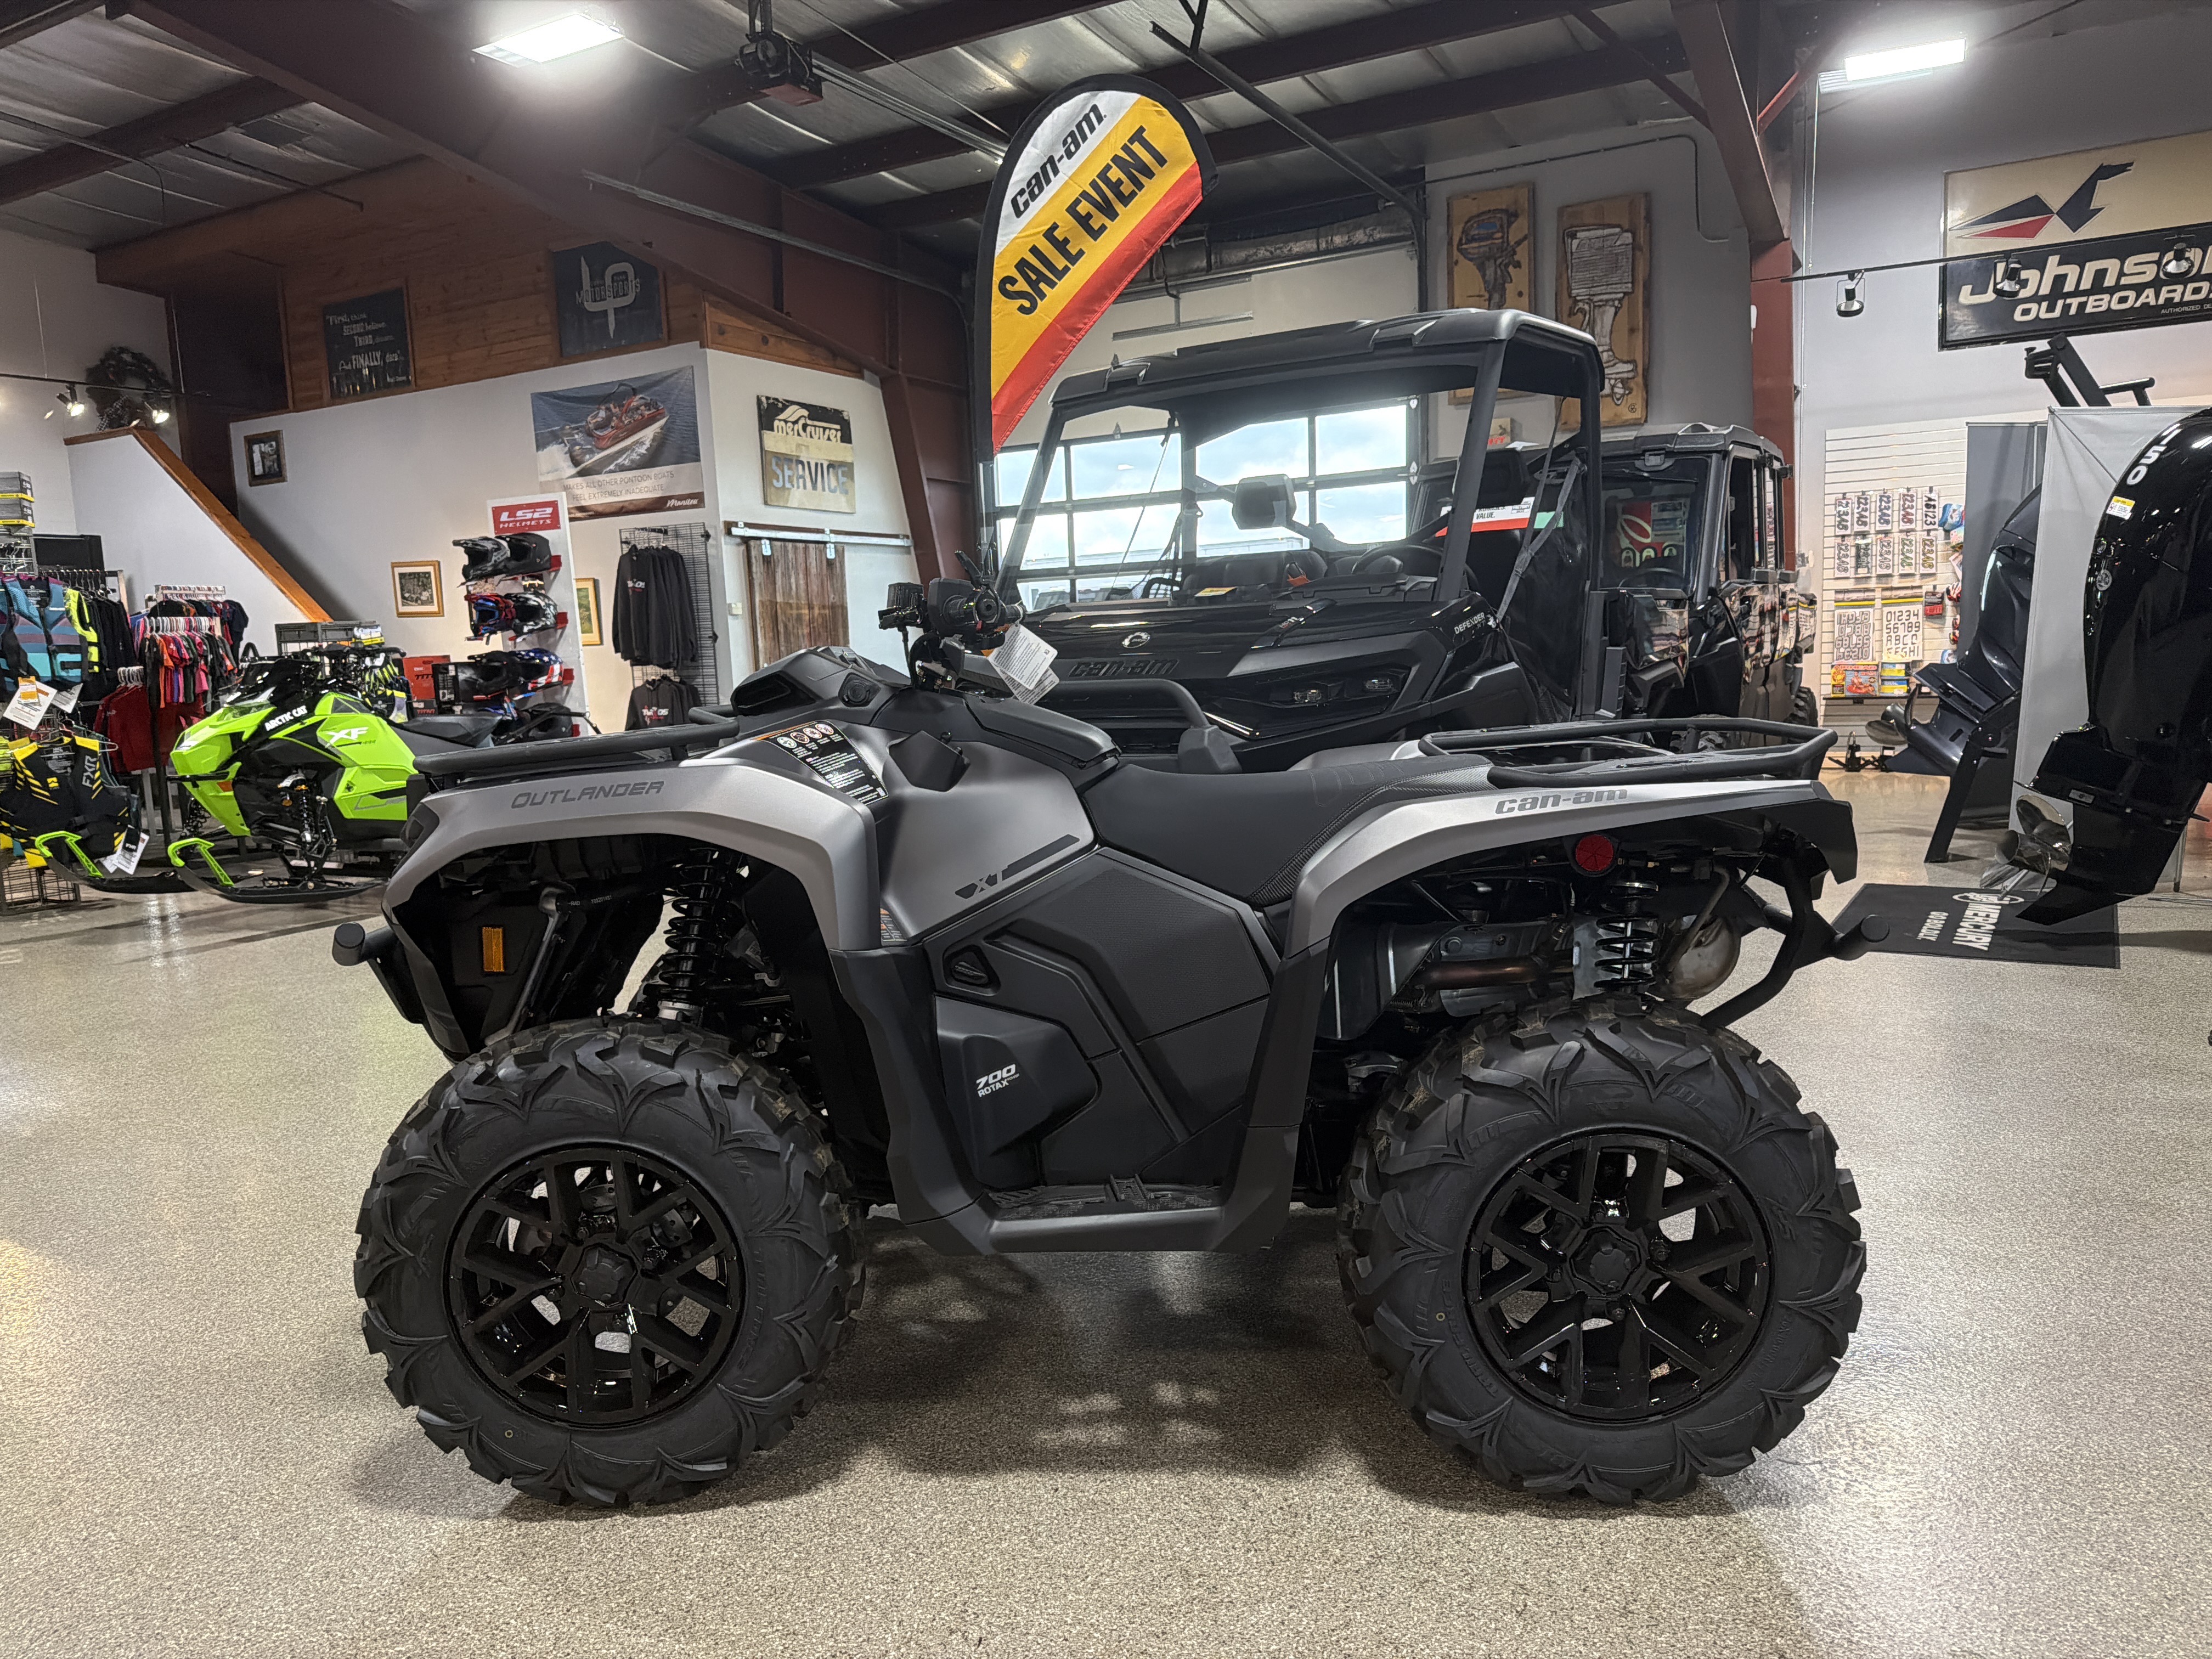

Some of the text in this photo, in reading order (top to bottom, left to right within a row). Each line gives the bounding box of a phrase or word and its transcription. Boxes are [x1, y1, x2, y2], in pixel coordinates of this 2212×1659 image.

[1011, 103, 1104, 220] can-am
[998, 125, 1169, 316] SALE EVENT
[1958, 247, 2212, 305] Johnso
[575, 278, 641, 305] MOTORSPORTS
[2160, 305, 2201, 314] AUTHORIZED
[563, 470, 674, 490] MAKES ALL OTHER PONTOON BOATS
[772, 456, 849, 495] SERVICE
[572, 483, 664, 501] FEEL EXTREMELY INADEQUATE
[499, 506, 554, 522] LS2
[499, 518, 554, 529] HELMETS
[1454, 612, 1486, 635] DEFENDER
[1068, 659, 1180, 678] can-am
[264, 705, 308, 731] ARCTIC CAT
[324, 727, 369, 749] XF
[82, 755, 97, 787] FXR
[511, 780, 664, 809] OUTLANDER
[1494, 788, 1628, 815] can-am
[1927, 911, 1949, 920] GO
[1952, 902, 2002, 951] MERCURY
[976, 1064, 1016, 1090] 700
[977, 1073, 1020, 1098] ROTAX POWER
